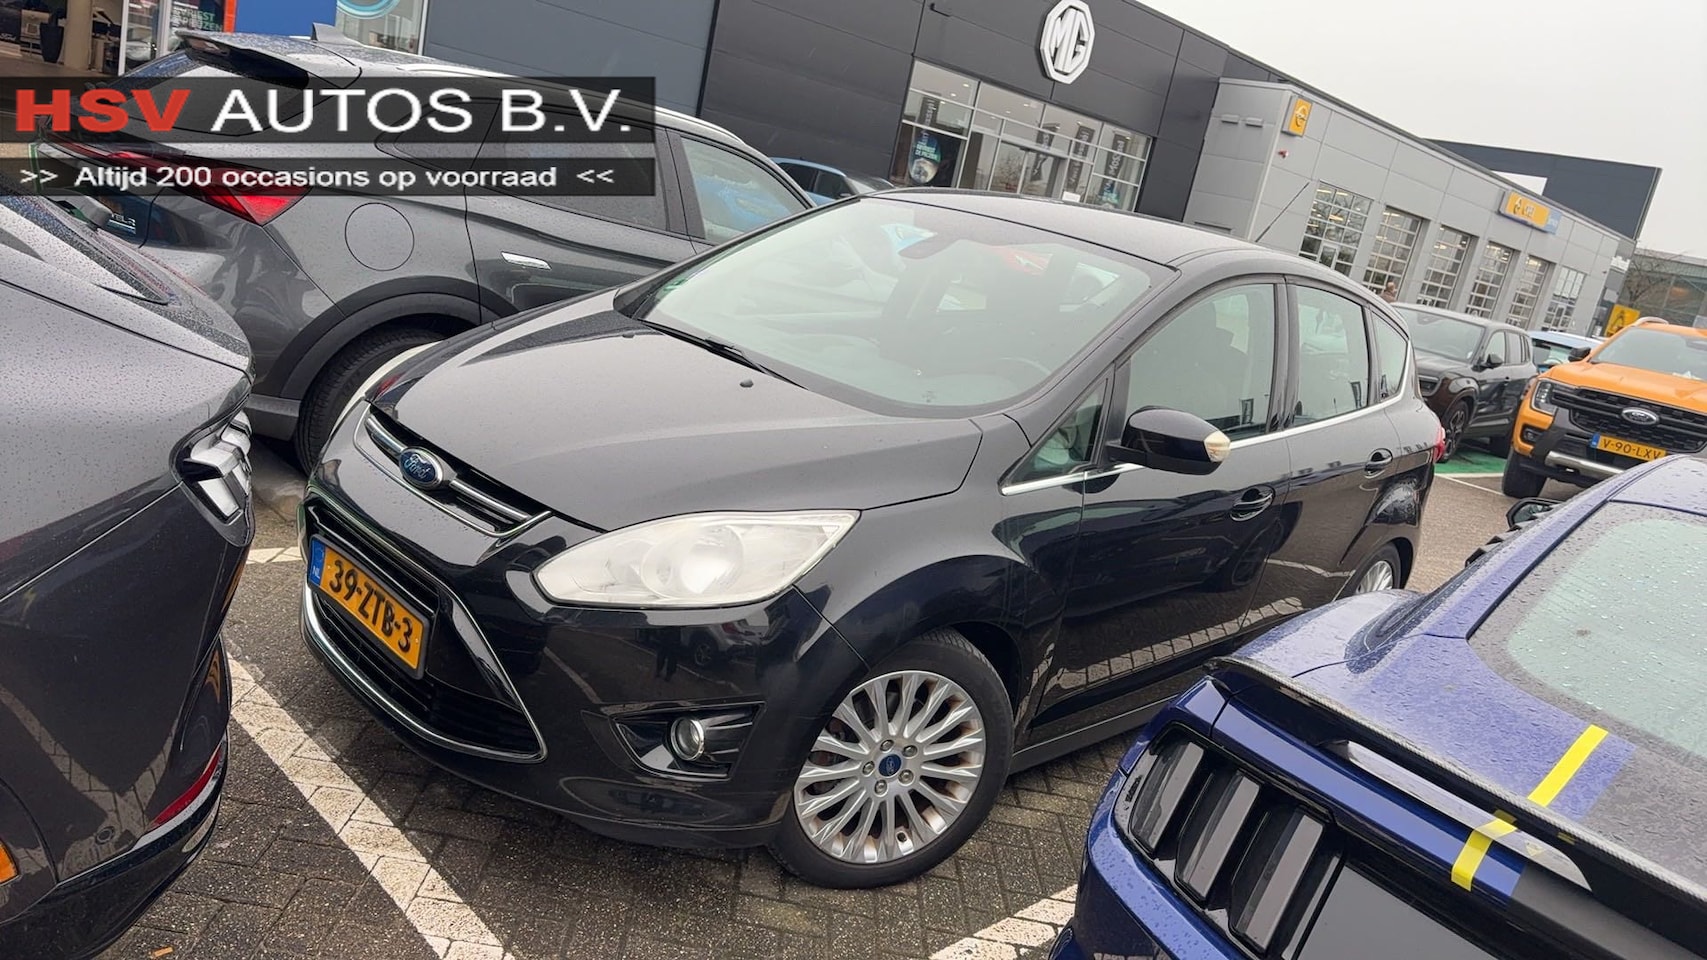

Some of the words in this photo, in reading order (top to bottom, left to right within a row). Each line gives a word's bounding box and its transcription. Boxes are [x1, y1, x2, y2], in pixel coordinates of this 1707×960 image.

[1049, 8, 1091, 74] MG
[403, 452, 431, 479] Ford
[1603, 438, 1662, 460] V-90-LXV
[328, 558, 413, 653] 39-ZTB-3
